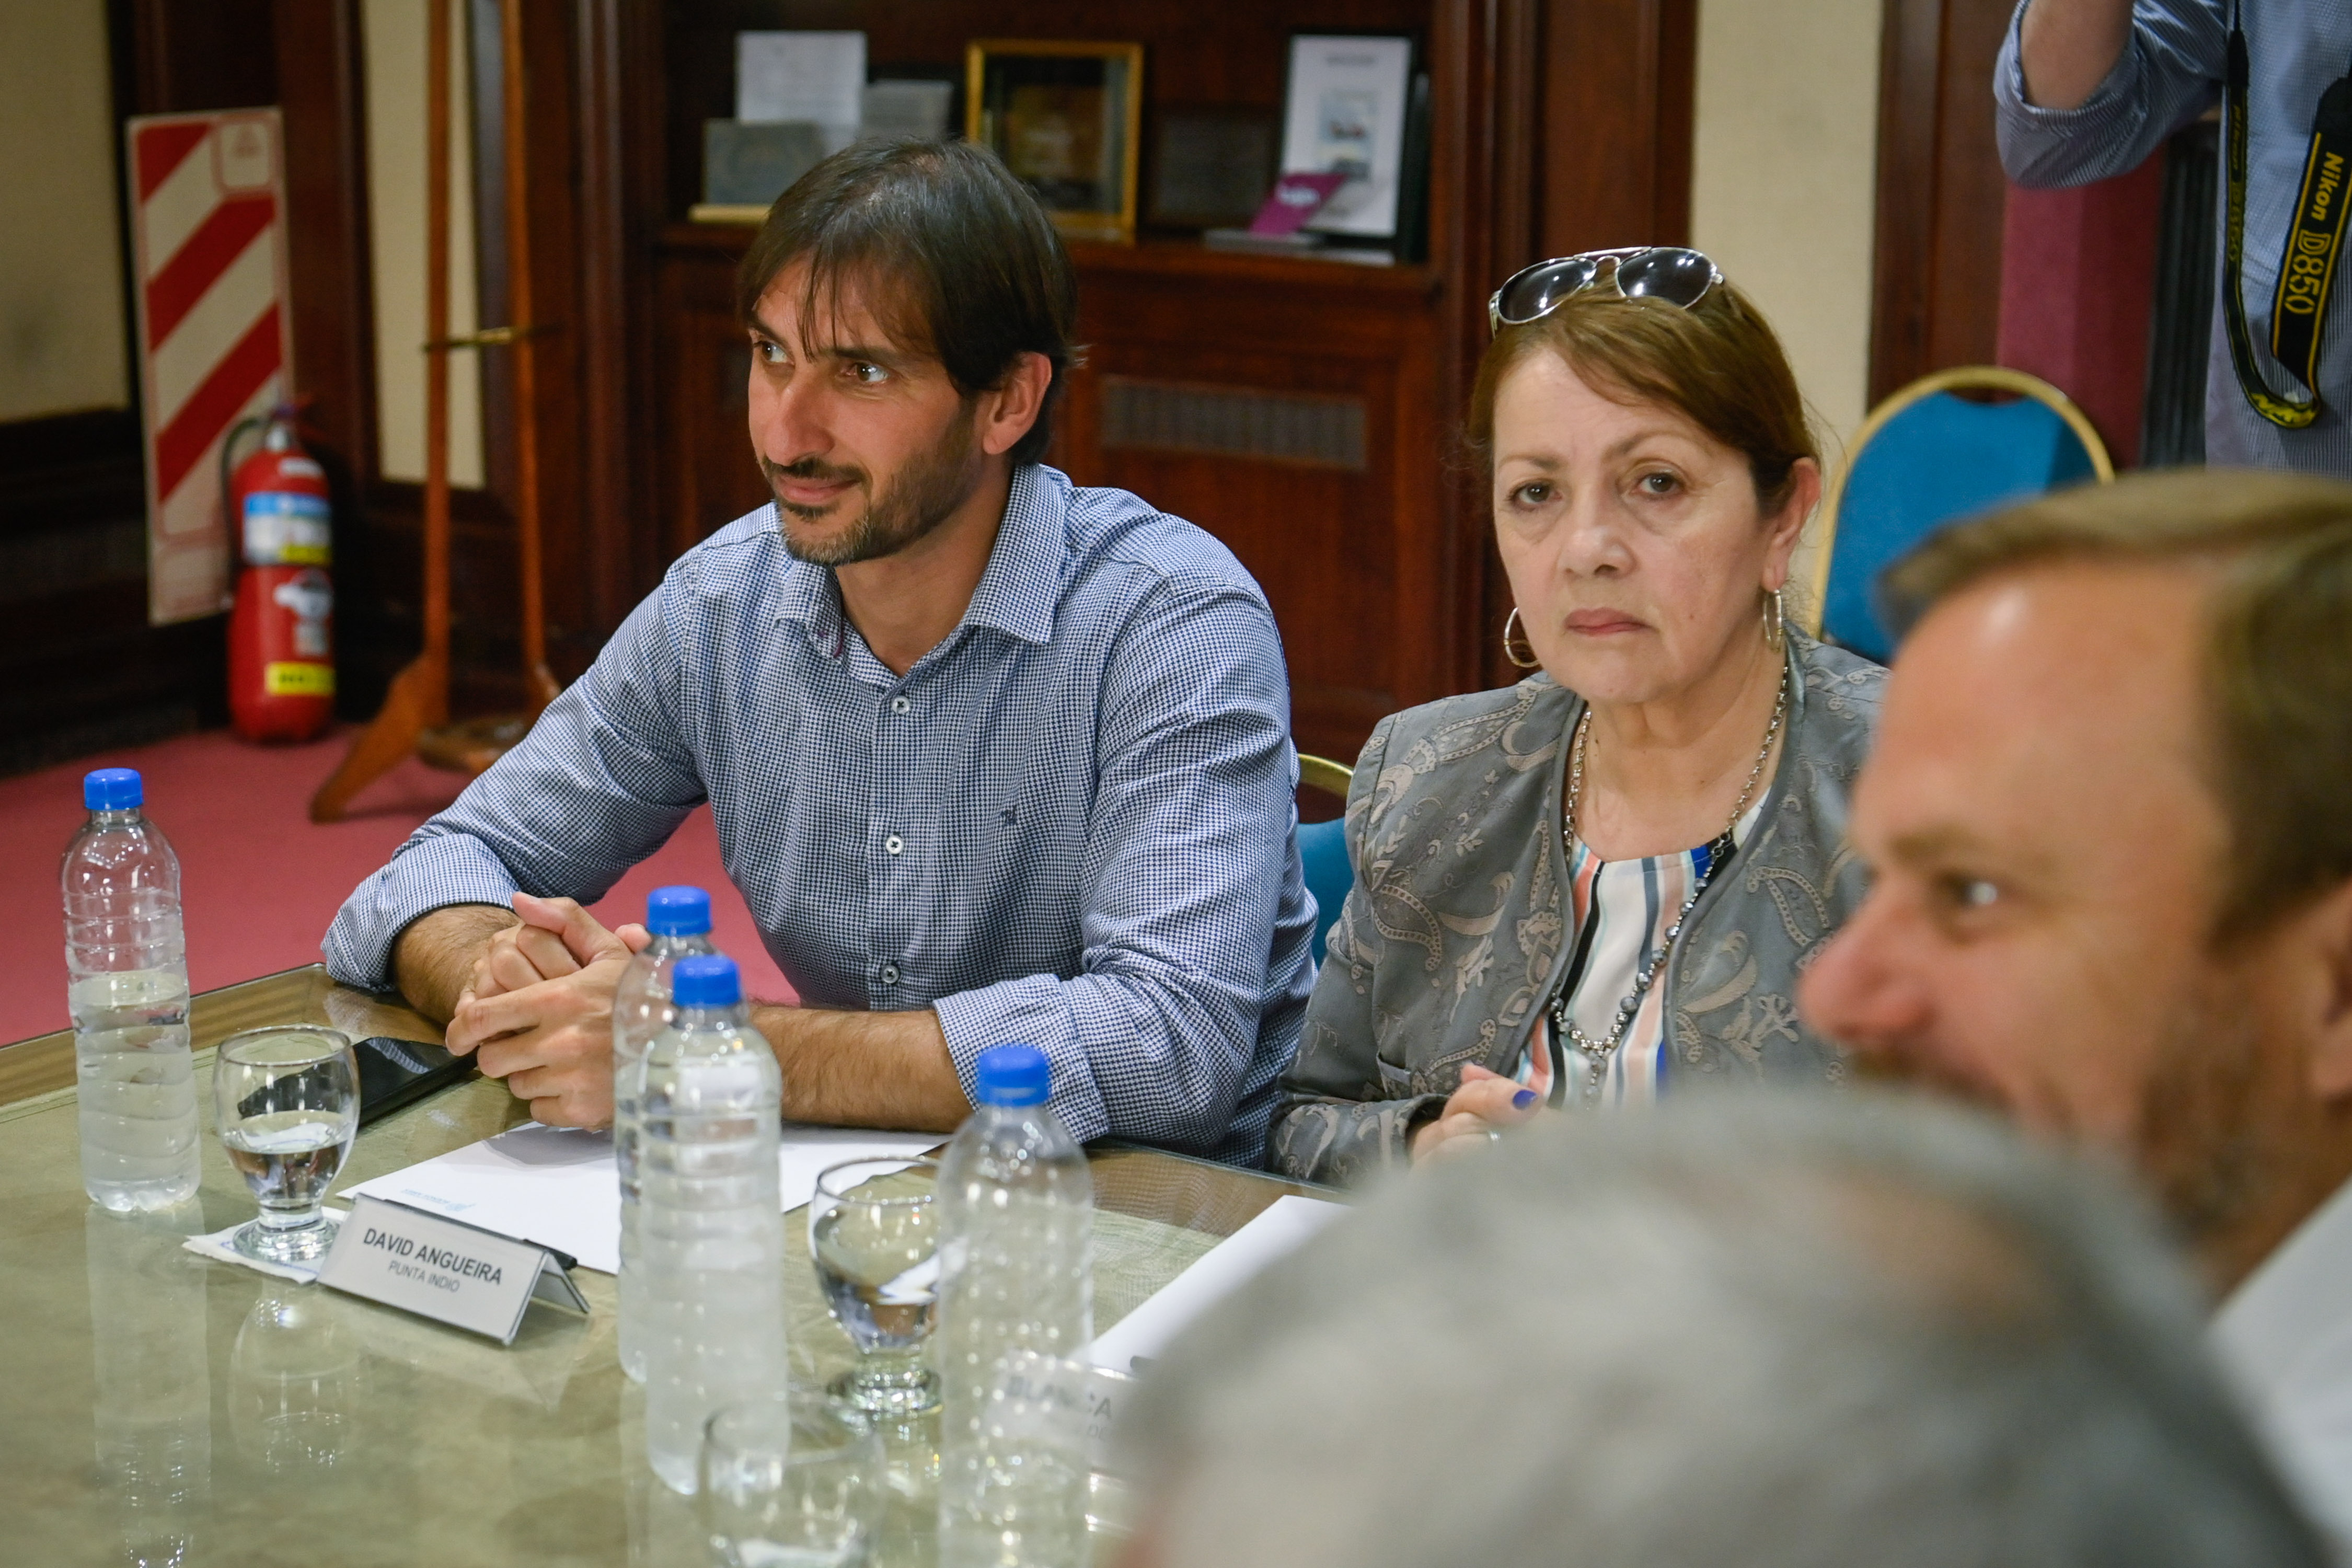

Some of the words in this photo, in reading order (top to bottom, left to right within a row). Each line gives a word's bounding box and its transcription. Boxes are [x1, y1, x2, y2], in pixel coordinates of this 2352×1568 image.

[2311, 152, 2344, 221] Nikon
[2284, 229, 2332, 314] D850
[363, 1228, 413, 1256] DAVID
[415, 1245, 502, 1285] ANGUEIRA
[388, 1260, 425, 1282] PUNTA
[426, 1273, 460, 1293] INDIO
